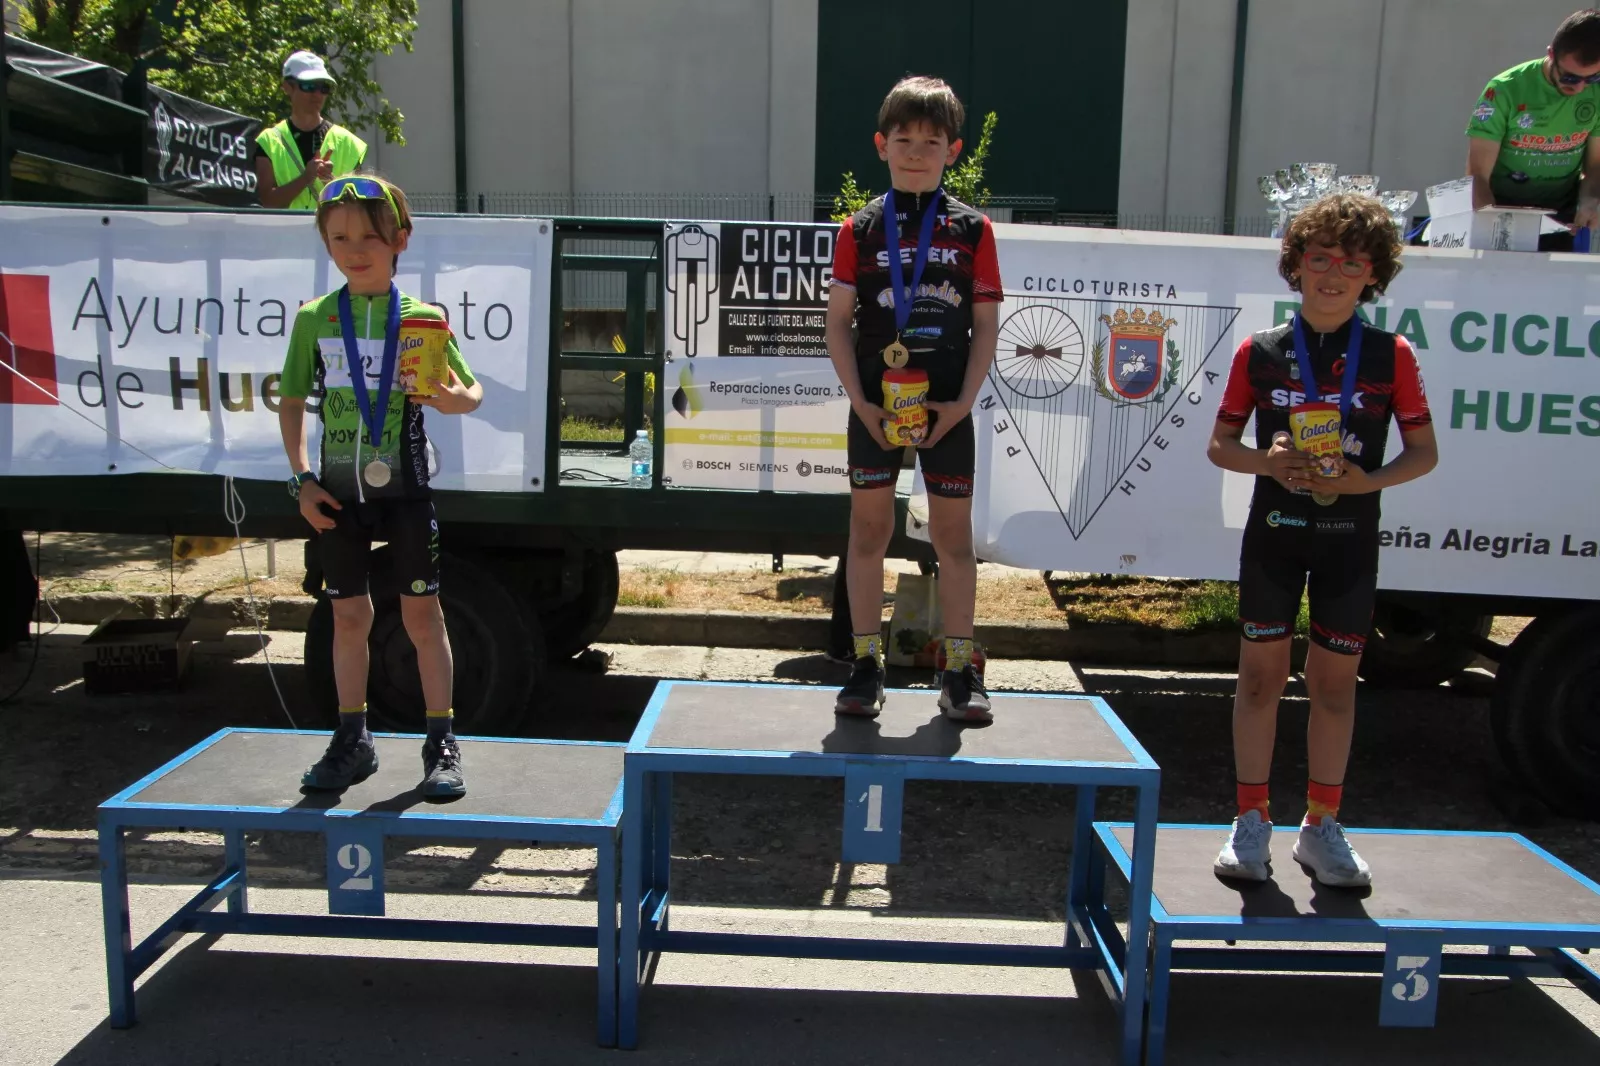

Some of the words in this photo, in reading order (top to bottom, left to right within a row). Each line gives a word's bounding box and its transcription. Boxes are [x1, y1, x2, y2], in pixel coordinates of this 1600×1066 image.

[173, 117, 247, 159] CICLOS
[171, 153, 257, 193] ALONSO
[742, 229, 833, 264] CICLO
[876, 247, 959, 267] SEEK
[731, 265, 833, 301] ALONS
[1023, 276, 1178, 299] CICLOTURISTA
[72, 277, 513, 349] Ayuntato
[728, 314, 747, 326] CALLE
[748, 314, 757, 326] DE
[758, 314, 766, 326] LA
[767, 314, 791, 327] FUENTE
[792, 315, 804, 327] DEL
[805, 315, 826, 328] ANGEL
[729, 345, 755, 354] Email:
[761, 345, 829, 356] info@ciclosalon
[746, 333, 827, 343] www.ciclosalonso.c
[77, 354, 145, 409] de
[709, 381, 791, 396] Reparaciones
[794, 384, 834, 397] Guara,
[741, 397, 759, 405] Plaza
[1271, 389, 1364, 409] SEEK
[699, 432, 731, 441] e-mail:
[979, 394, 1021, 458] PEÑ
[1120, 369, 1220, 496] HUESCA
[696, 460, 731, 470] BOSCH
[739, 462, 789, 473] SIEMENS
[813, 464, 848, 477] Balay
[1378, 525, 1431, 549] eña
[1440, 528, 1551, 559] Alegria
[1561, 534, 1600, 558] La
[859, 784, 884, 832] 1
[337, 843, 374, 891] 2
[1391, 955, 1430, 1002] 3
